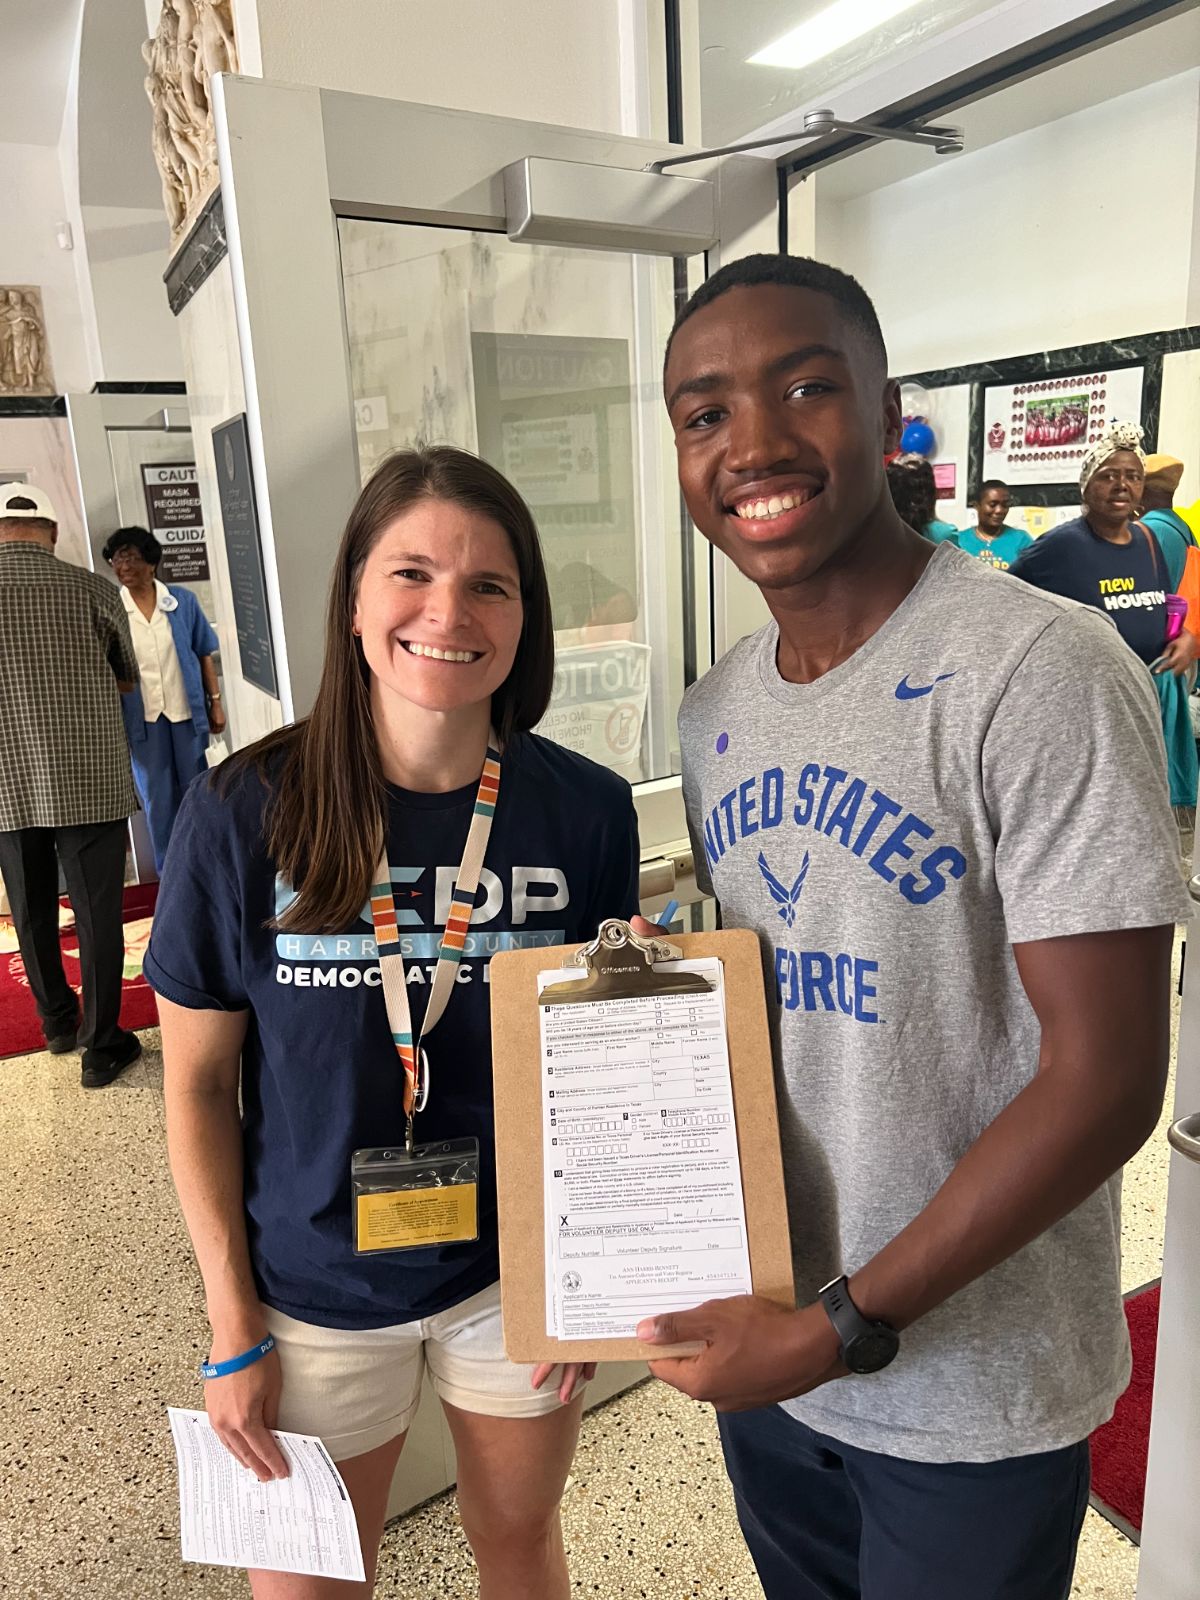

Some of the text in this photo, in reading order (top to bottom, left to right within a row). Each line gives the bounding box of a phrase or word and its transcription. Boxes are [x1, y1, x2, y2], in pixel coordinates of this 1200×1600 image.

[158, 470, 196, 482] CAUT
[163, 488, 190, 496] MASK
[154, 498, 201, 508] REQUIRED
[1099, 577, 1134, 594] new
[704, 764, 966, 904] NITED STATES
[286, 938, 414, 956] HARRS
[276, 964, 472, 987] DEMOCATC
[560, 1216, 568, 1226] X
